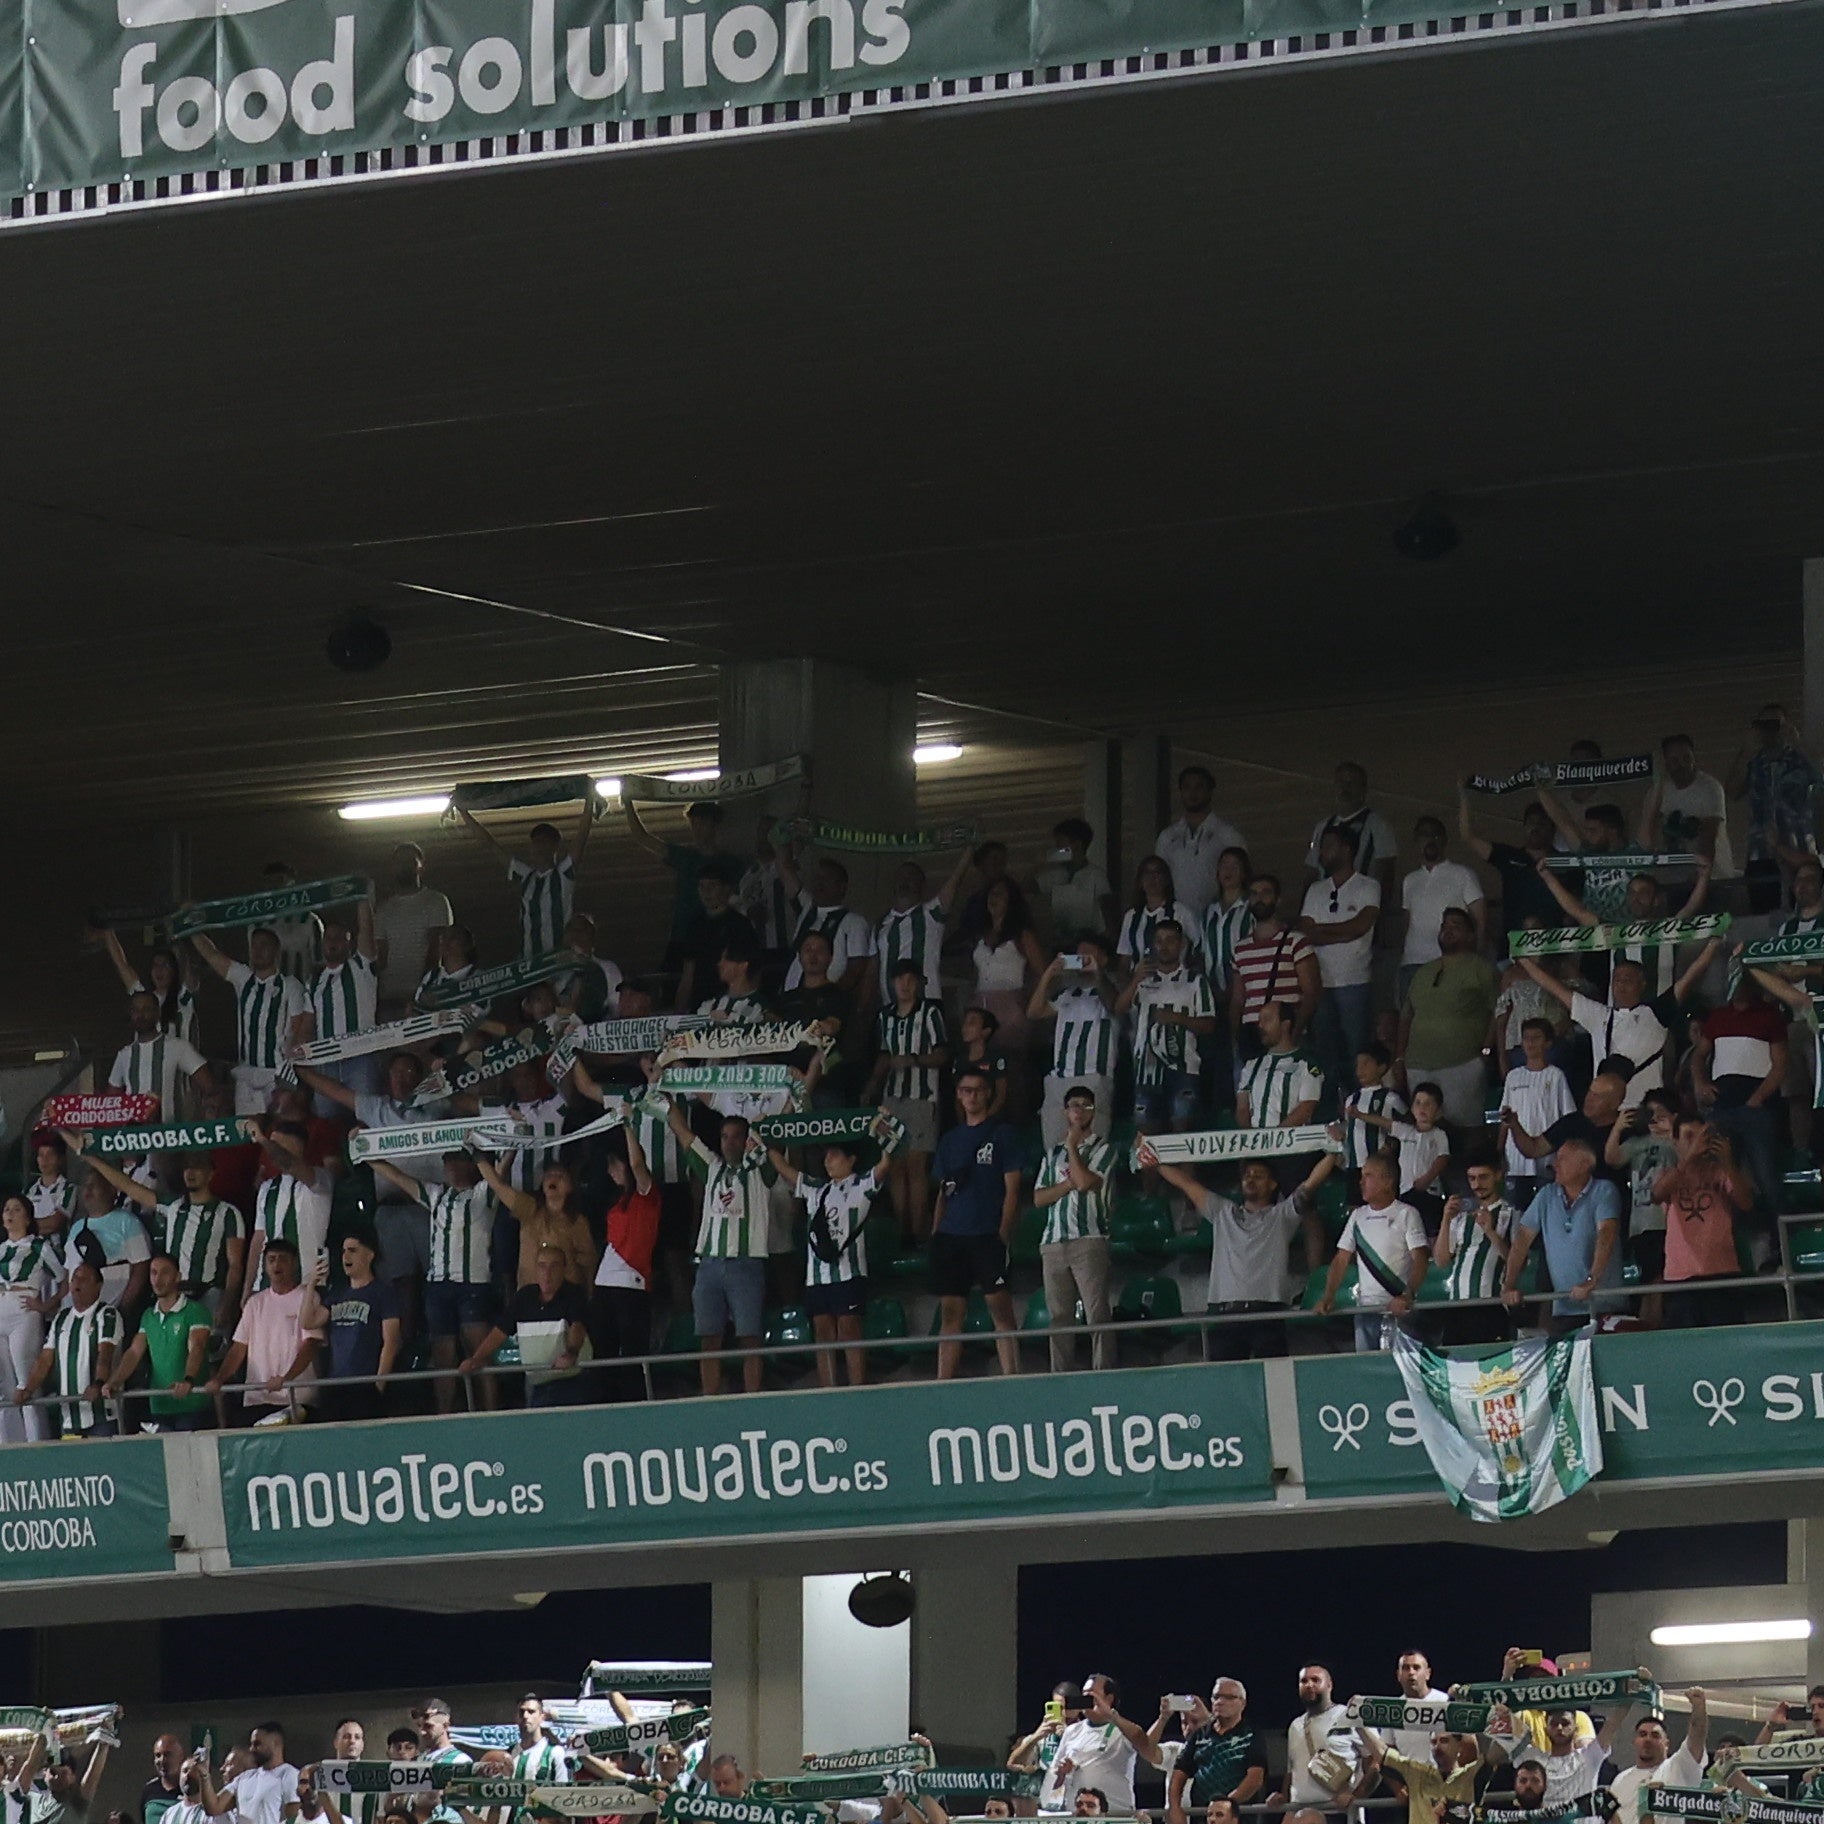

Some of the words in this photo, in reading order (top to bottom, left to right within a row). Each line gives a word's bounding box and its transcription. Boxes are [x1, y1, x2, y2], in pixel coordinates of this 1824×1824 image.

[113, 17, 354, 158] food
[404, 0, 911, 120] solutions
[81, 1094, 123, 1111] MUJER
[61, 1109, 138, 1126] CORDOBESA
[100, 1128, 190, 1152] CÓRDOBA
[194, 1125, 231, 1145] C.F.
[1184, 1130, 1296, 1156] VOLVEREMOS
[2, 1517, 96, 1551] CORDOBA
[1653, 1789, 1721, 1814] Brigadas
